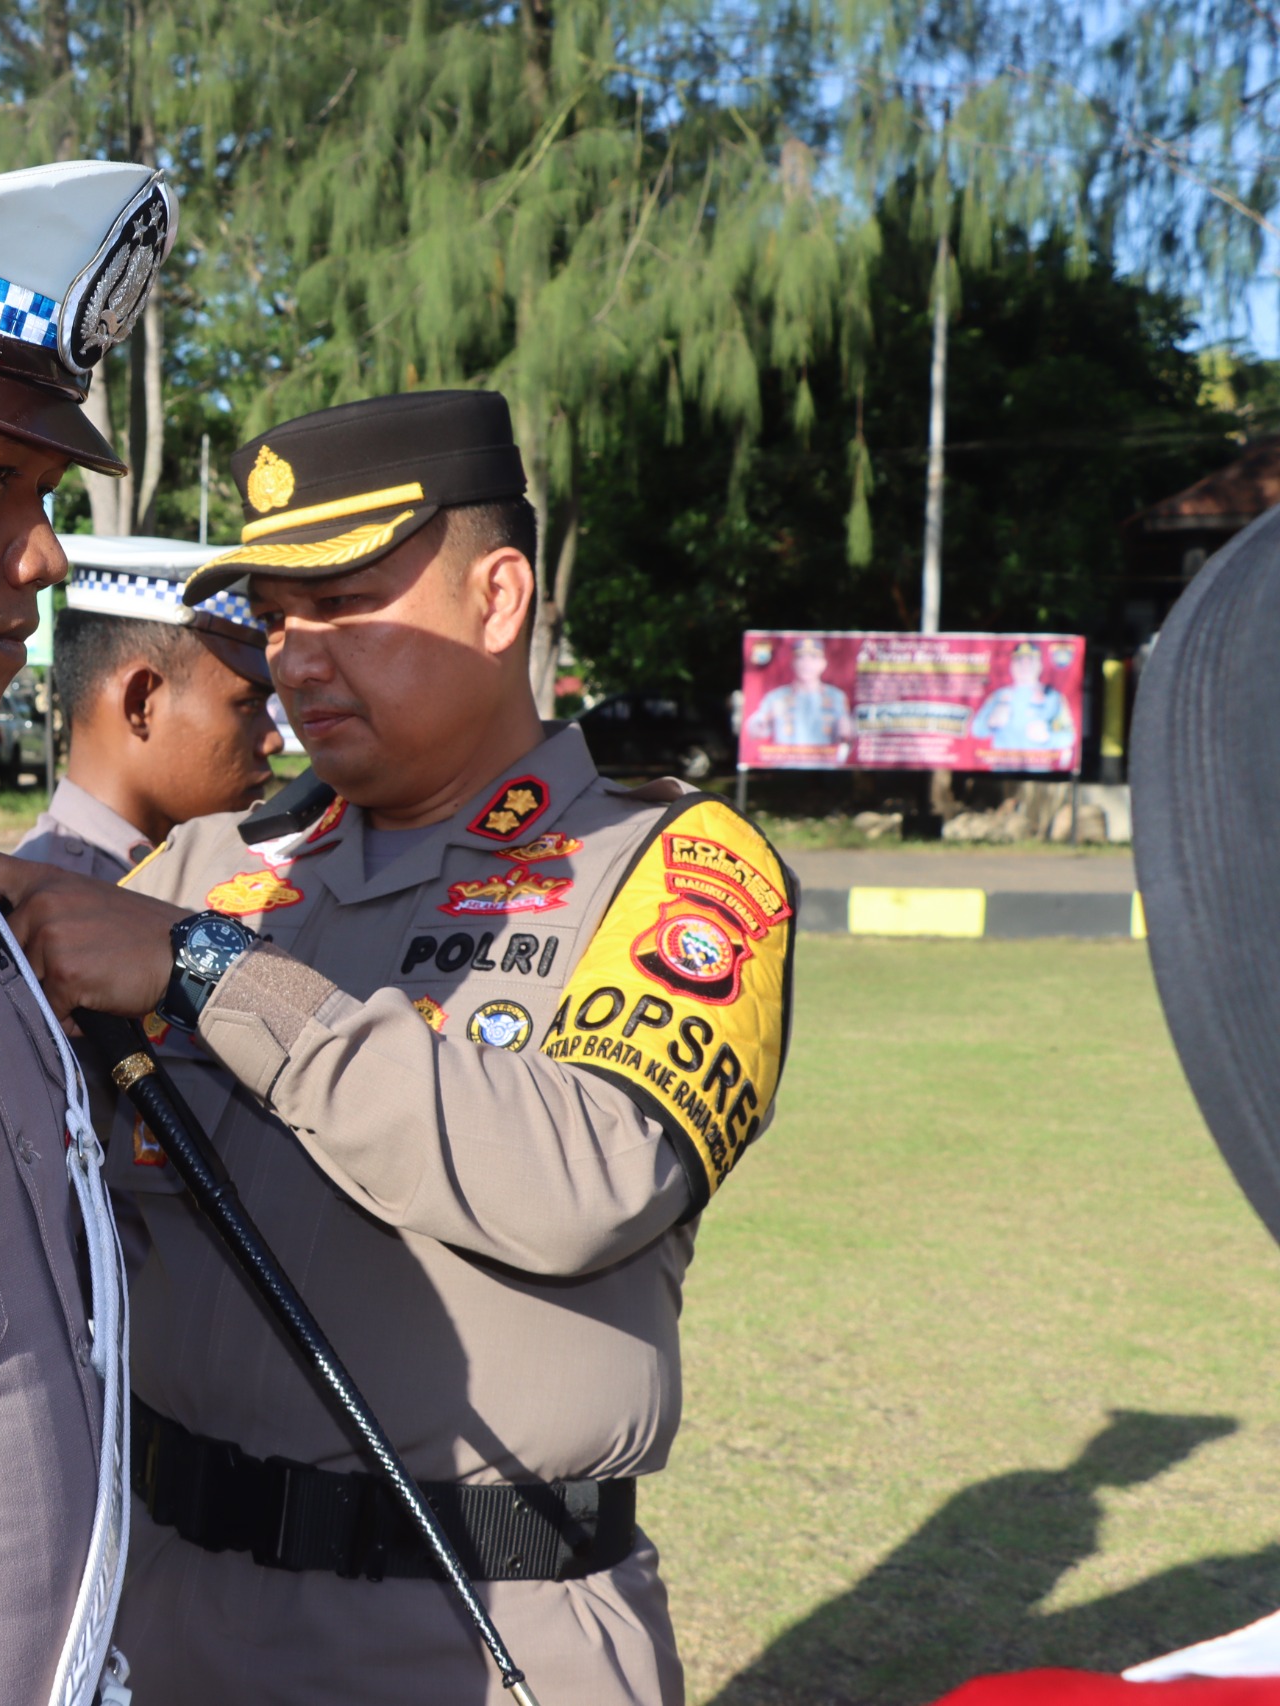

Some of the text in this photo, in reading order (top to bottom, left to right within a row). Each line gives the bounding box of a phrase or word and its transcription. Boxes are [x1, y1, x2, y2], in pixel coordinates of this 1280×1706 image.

[672, 838, 782, 912] POLRES
[673, 877, 759, 931] MALUKU UTARA
[401, 932, 559, 978] POLRI
[543, 1035, 712, 1136] NTAP BRATA KIE RAHA
